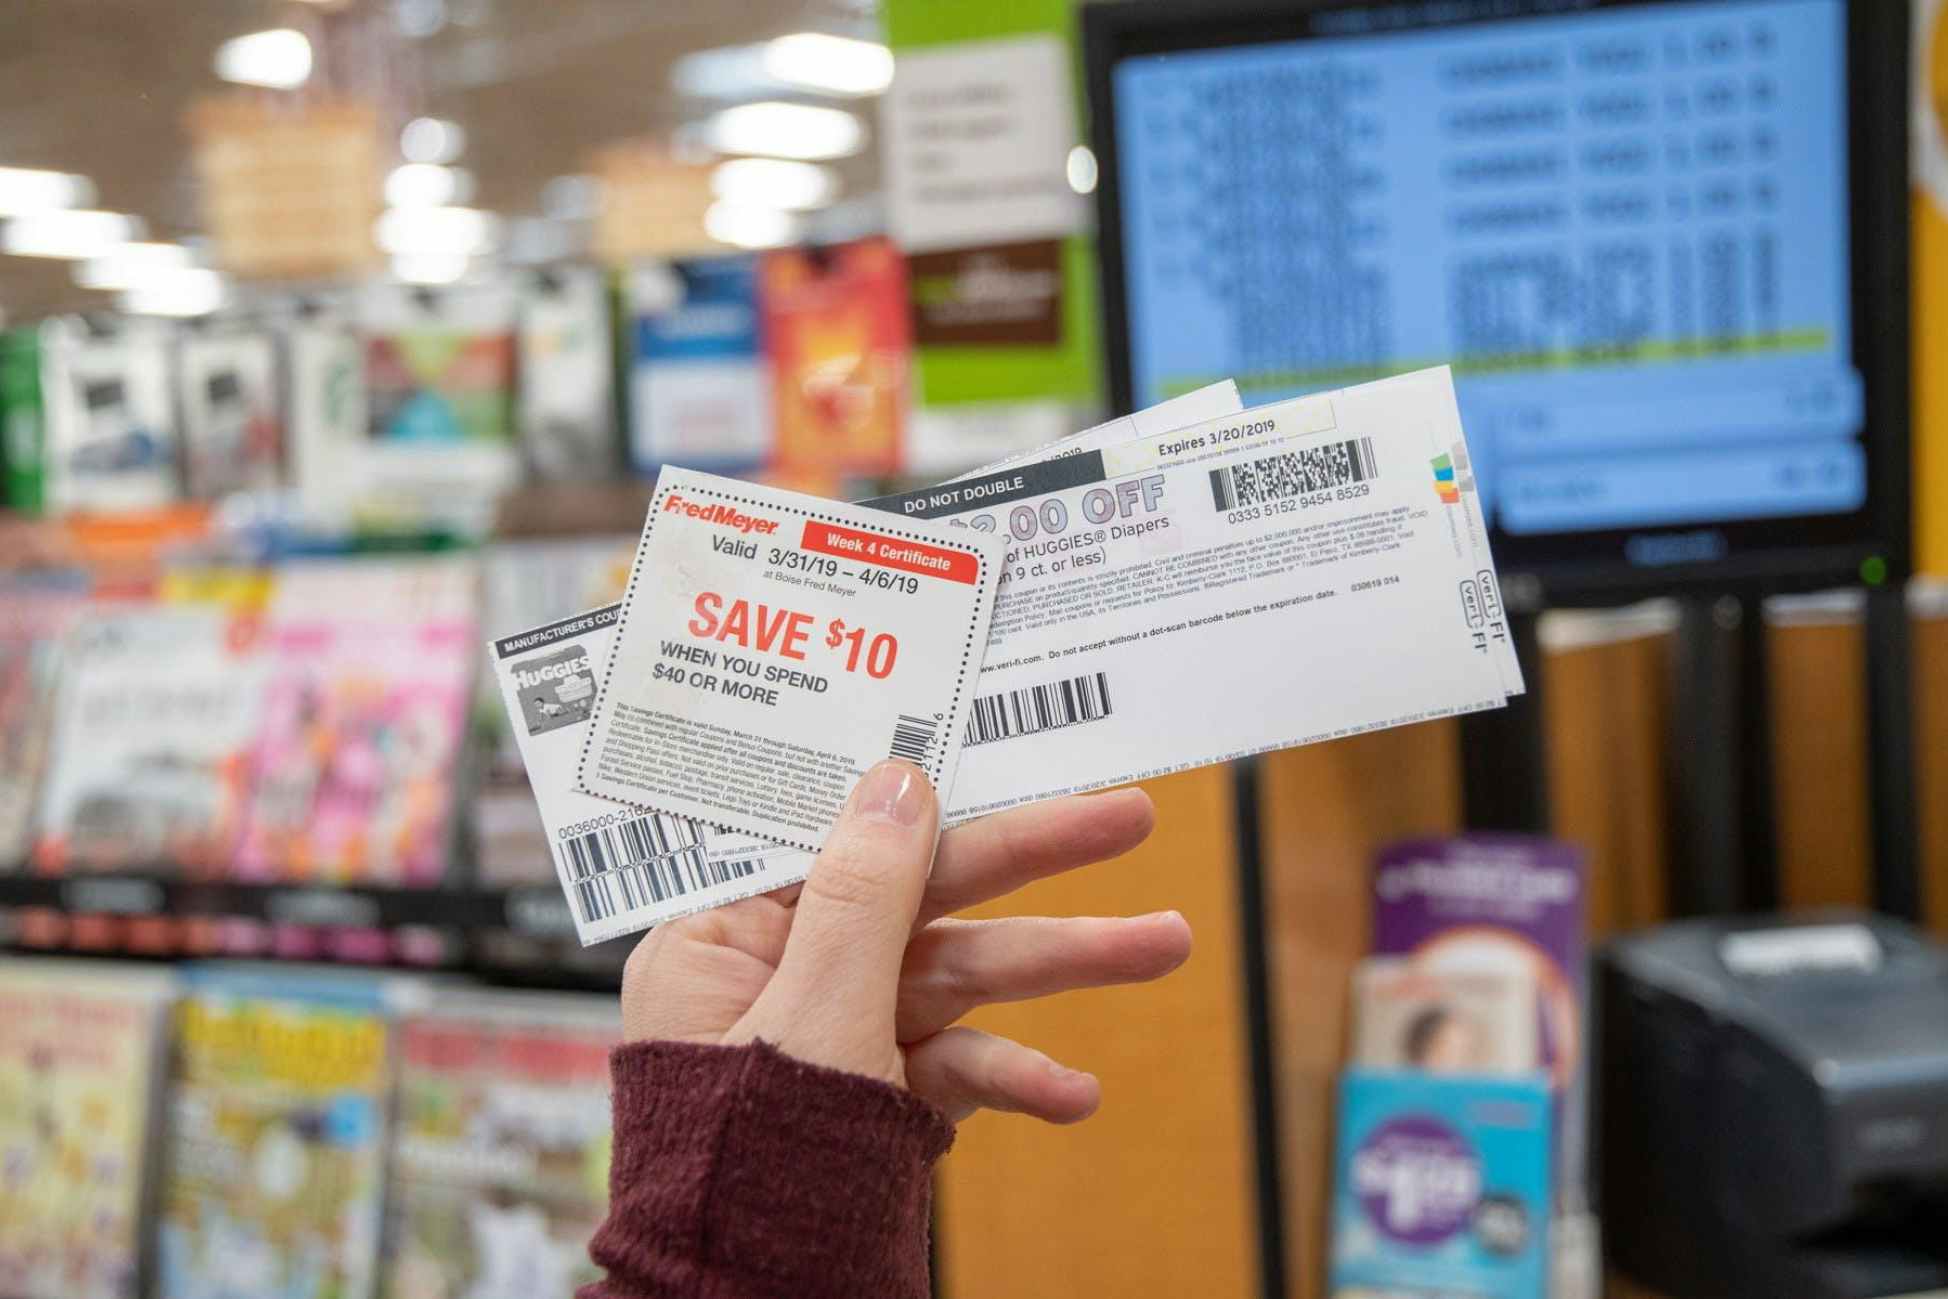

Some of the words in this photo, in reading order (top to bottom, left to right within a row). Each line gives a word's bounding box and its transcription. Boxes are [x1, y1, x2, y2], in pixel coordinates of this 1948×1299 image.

[1158, 435, 1206, 457] Expires
[1208, 419, 1276, 445] 3/20/2019
[664, 495, 779, 536] FredMeyer
[903, 497, 926, 514] DO
[929, 490, 961, 508] NOT
[963, 476, 1024, 501] DOUBLE
[1081, 474, 1166, 525] OFF
[1227, 506, 1261, 524] 0333
[1263, 499, 1296, 516] 5152
[1299, 491, 1333, 509] 9454
[1335, 483, 1370, 501] 8529
[825, 531, 864, 552] Week
[865, 540, 876, 555] 4
[880, 544, 950, 572] Certificate
[1005, 546, 1022, 563] of
[1110, 516, 1170, 541] Diapers
[711, 534, 758, 560] Valid
[768, 547, 838, 578] 3/31/19
[858, 566, 919, 596] 4/6/19
[1015, 566, 1026, 580] 9
[1030, 562, 1046, 577] ct.
[1050, 559, 1067, 573] or
[1070, 546, 1106, 570] less)
[803, 577, 825, 590] Fred
[826, 582, 856, 599] Meyer
[504, 618, 595, 653] MANUFACTURER'S
[688, 591, 814, 661] SAVE
[825, 617, 899, 680] $10
[1048, 649, 1060, 659] Do
[1062, 646, 1077, 656] not
[1078, 639, 1107, 654] accept
[1107, 632, 1140, 646] without
[1148, 621, 1186, 636] dot-scan
[1188, 613, 1223, 627] barcode
[1224, 607, 1251, 619] below
[1252, 603, 1268, 613] the
[1269, 593, 1313, 611] expiration
[510, 655, 590, 690] HUGGIES
[651, 662, 685, 684] $40
[688, 670, 718, 691] OR
[721, 676, 779, 707] MORE
[658, 640, 716, 667] WHEN
[720, 654, 761, 678] YOU
[764, 663, 829, 695] SPEND
